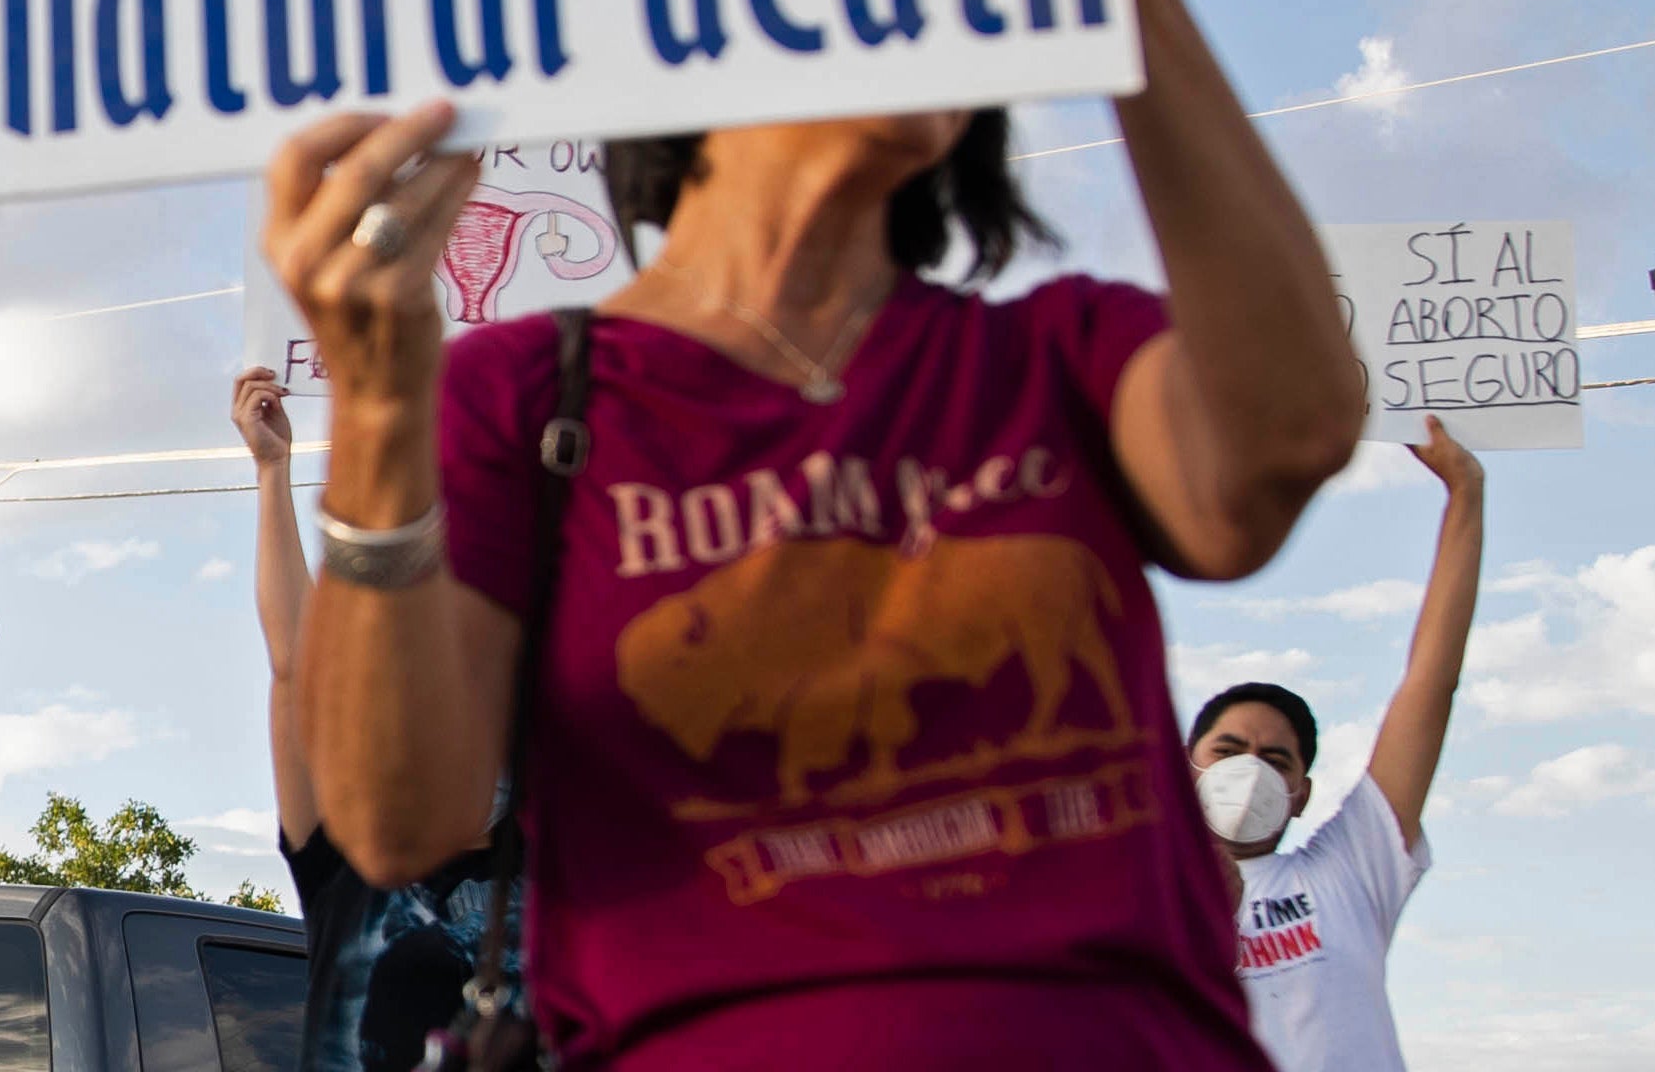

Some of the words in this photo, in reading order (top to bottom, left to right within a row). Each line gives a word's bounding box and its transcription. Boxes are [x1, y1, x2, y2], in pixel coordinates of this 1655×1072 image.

[1403, 222, 1475, 286] SÍ
[1492, 230, 1563, 287] AL
[1387, 292, 1568, 343] ABORTO
[1382, 348, 1580, 407] SEGURO
[606, 450, 882, 579] ROAM
